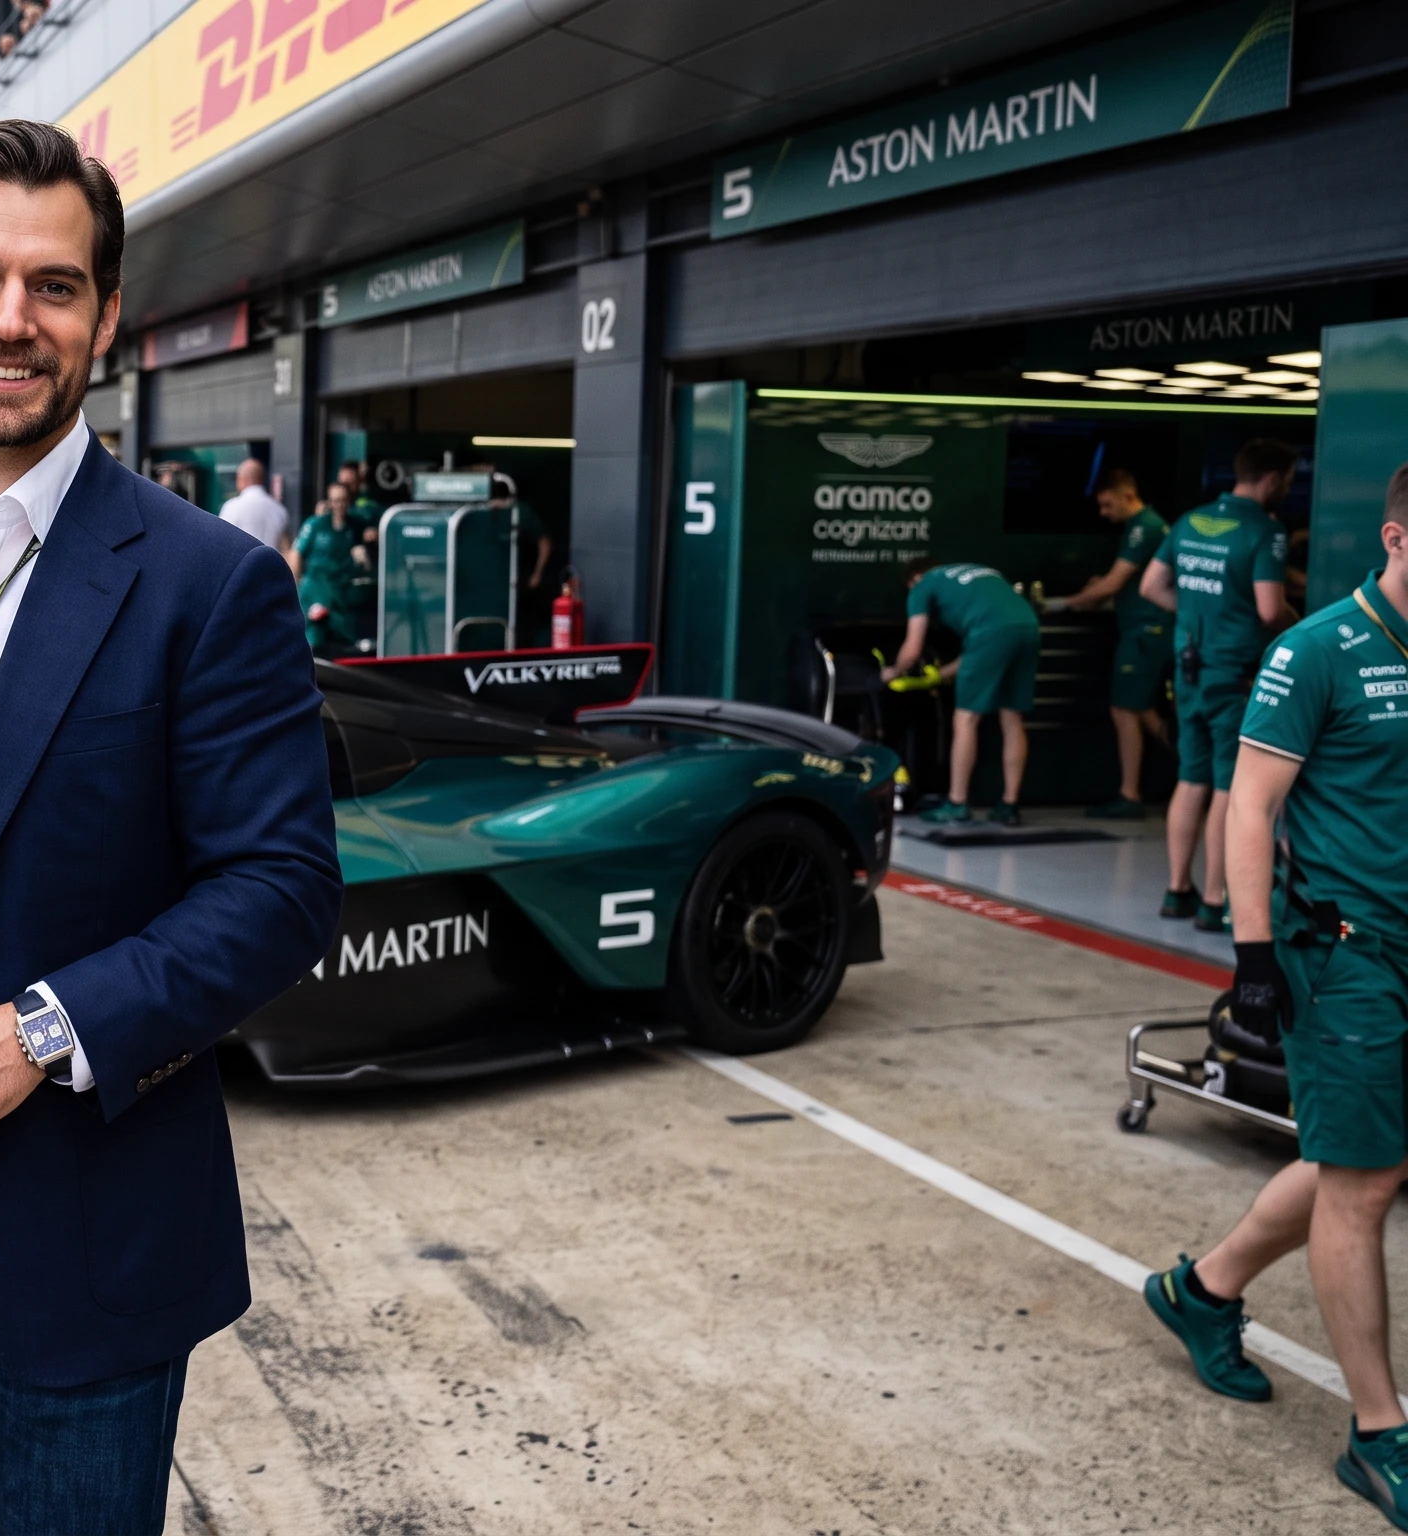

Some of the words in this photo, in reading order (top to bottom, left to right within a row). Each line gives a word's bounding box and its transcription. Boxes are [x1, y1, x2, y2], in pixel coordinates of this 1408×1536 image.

[722, 166, 754, 220] 5
[827, 119, 936, 188] ASTON
[945, 73, 1098, 158] MARTIN
[323, 283, 339, 318] 5
[365, 270, 407, 302] ASTON
[408, 252, 462, 290] MARTIN
[581, 297, 616, 353] 02
[1089, 315, 1174, 351] ASTON
[1182, 301, 1295, 342] MARTIN
[684, 481, 716, 535] 5
[814, 484, 933, 512] aramco
[813, 515, 931, 547] cognizant
[464, 657, 595, 694] VALKYRIE
[1358, 664, 1407, 678] aramco
[339, 909, 489, 977] MARTIN
[598, 888, 655, 950] 5
